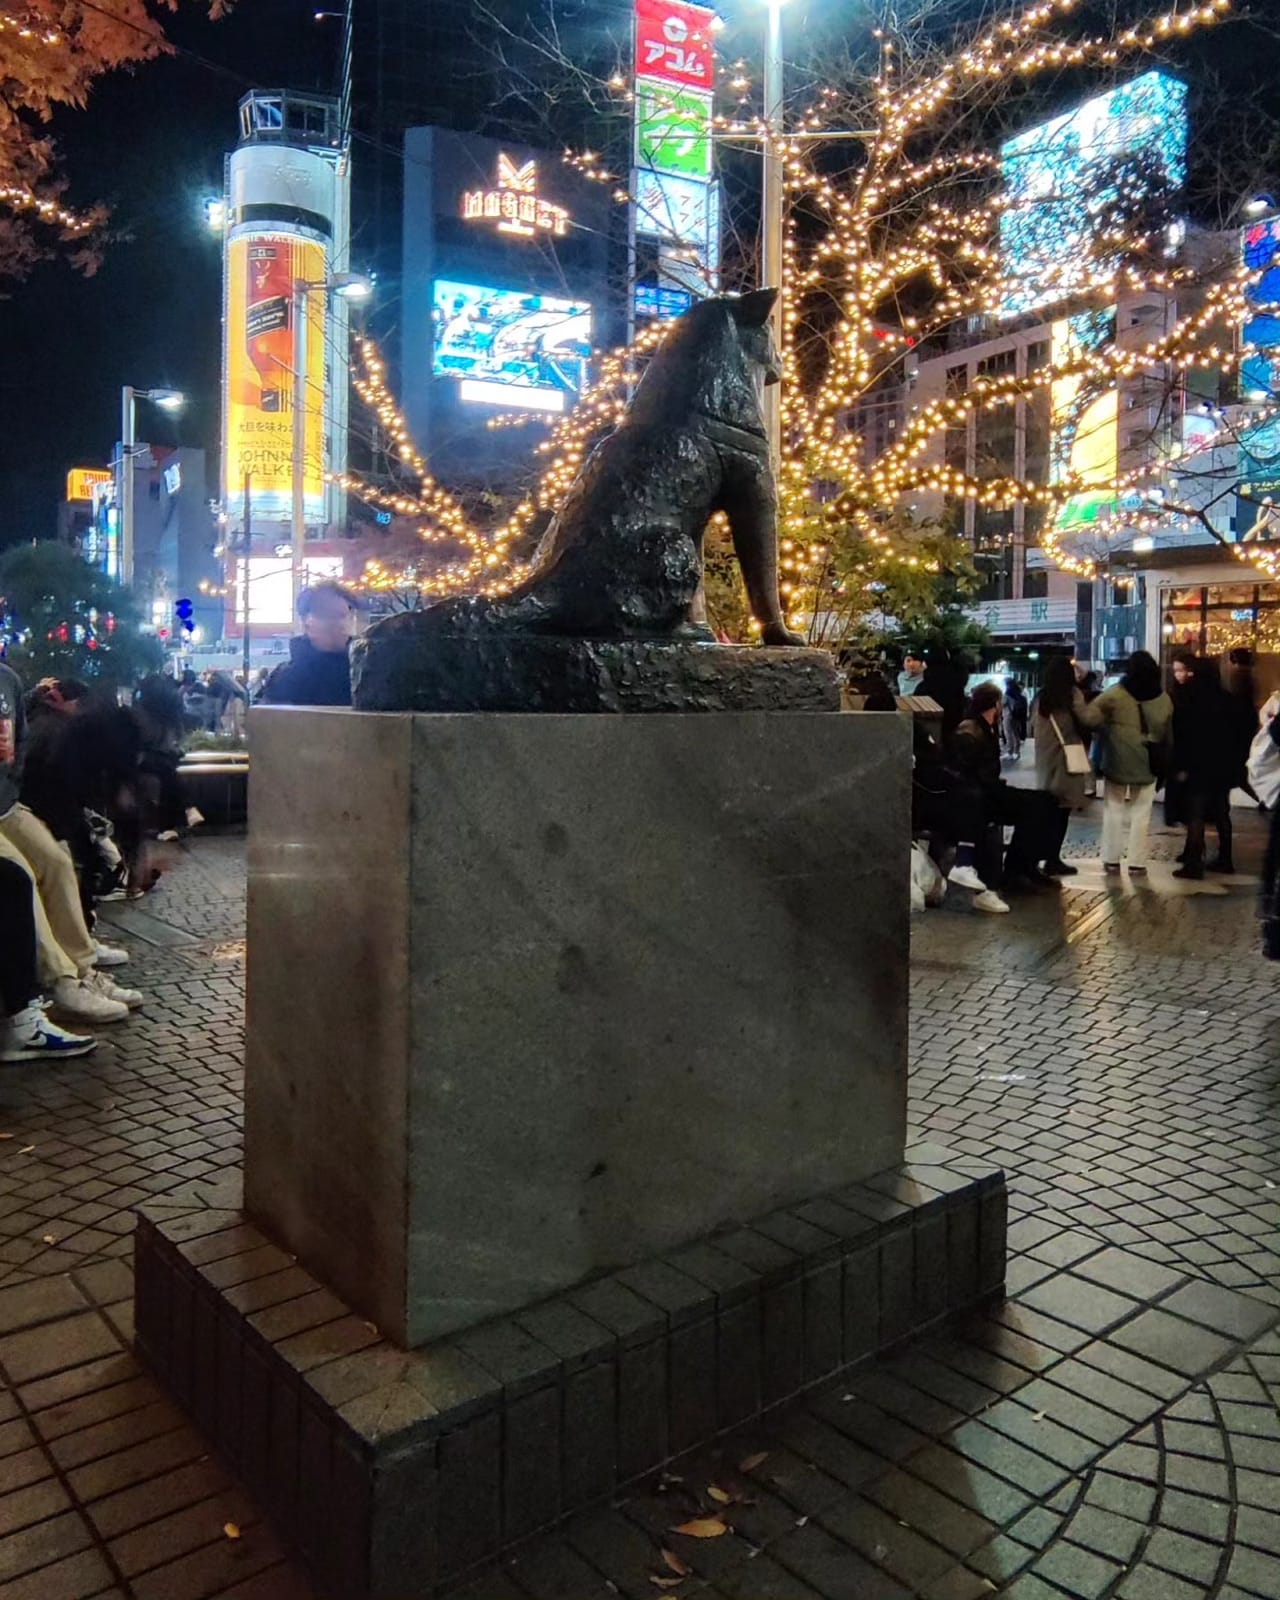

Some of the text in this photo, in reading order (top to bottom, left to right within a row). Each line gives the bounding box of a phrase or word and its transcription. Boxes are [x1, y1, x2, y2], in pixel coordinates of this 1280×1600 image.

[644, 39, 705, 78] アコム
[238, 449, 309, 463] JOHNNE
[239, 463, 306, 476] WALKE
